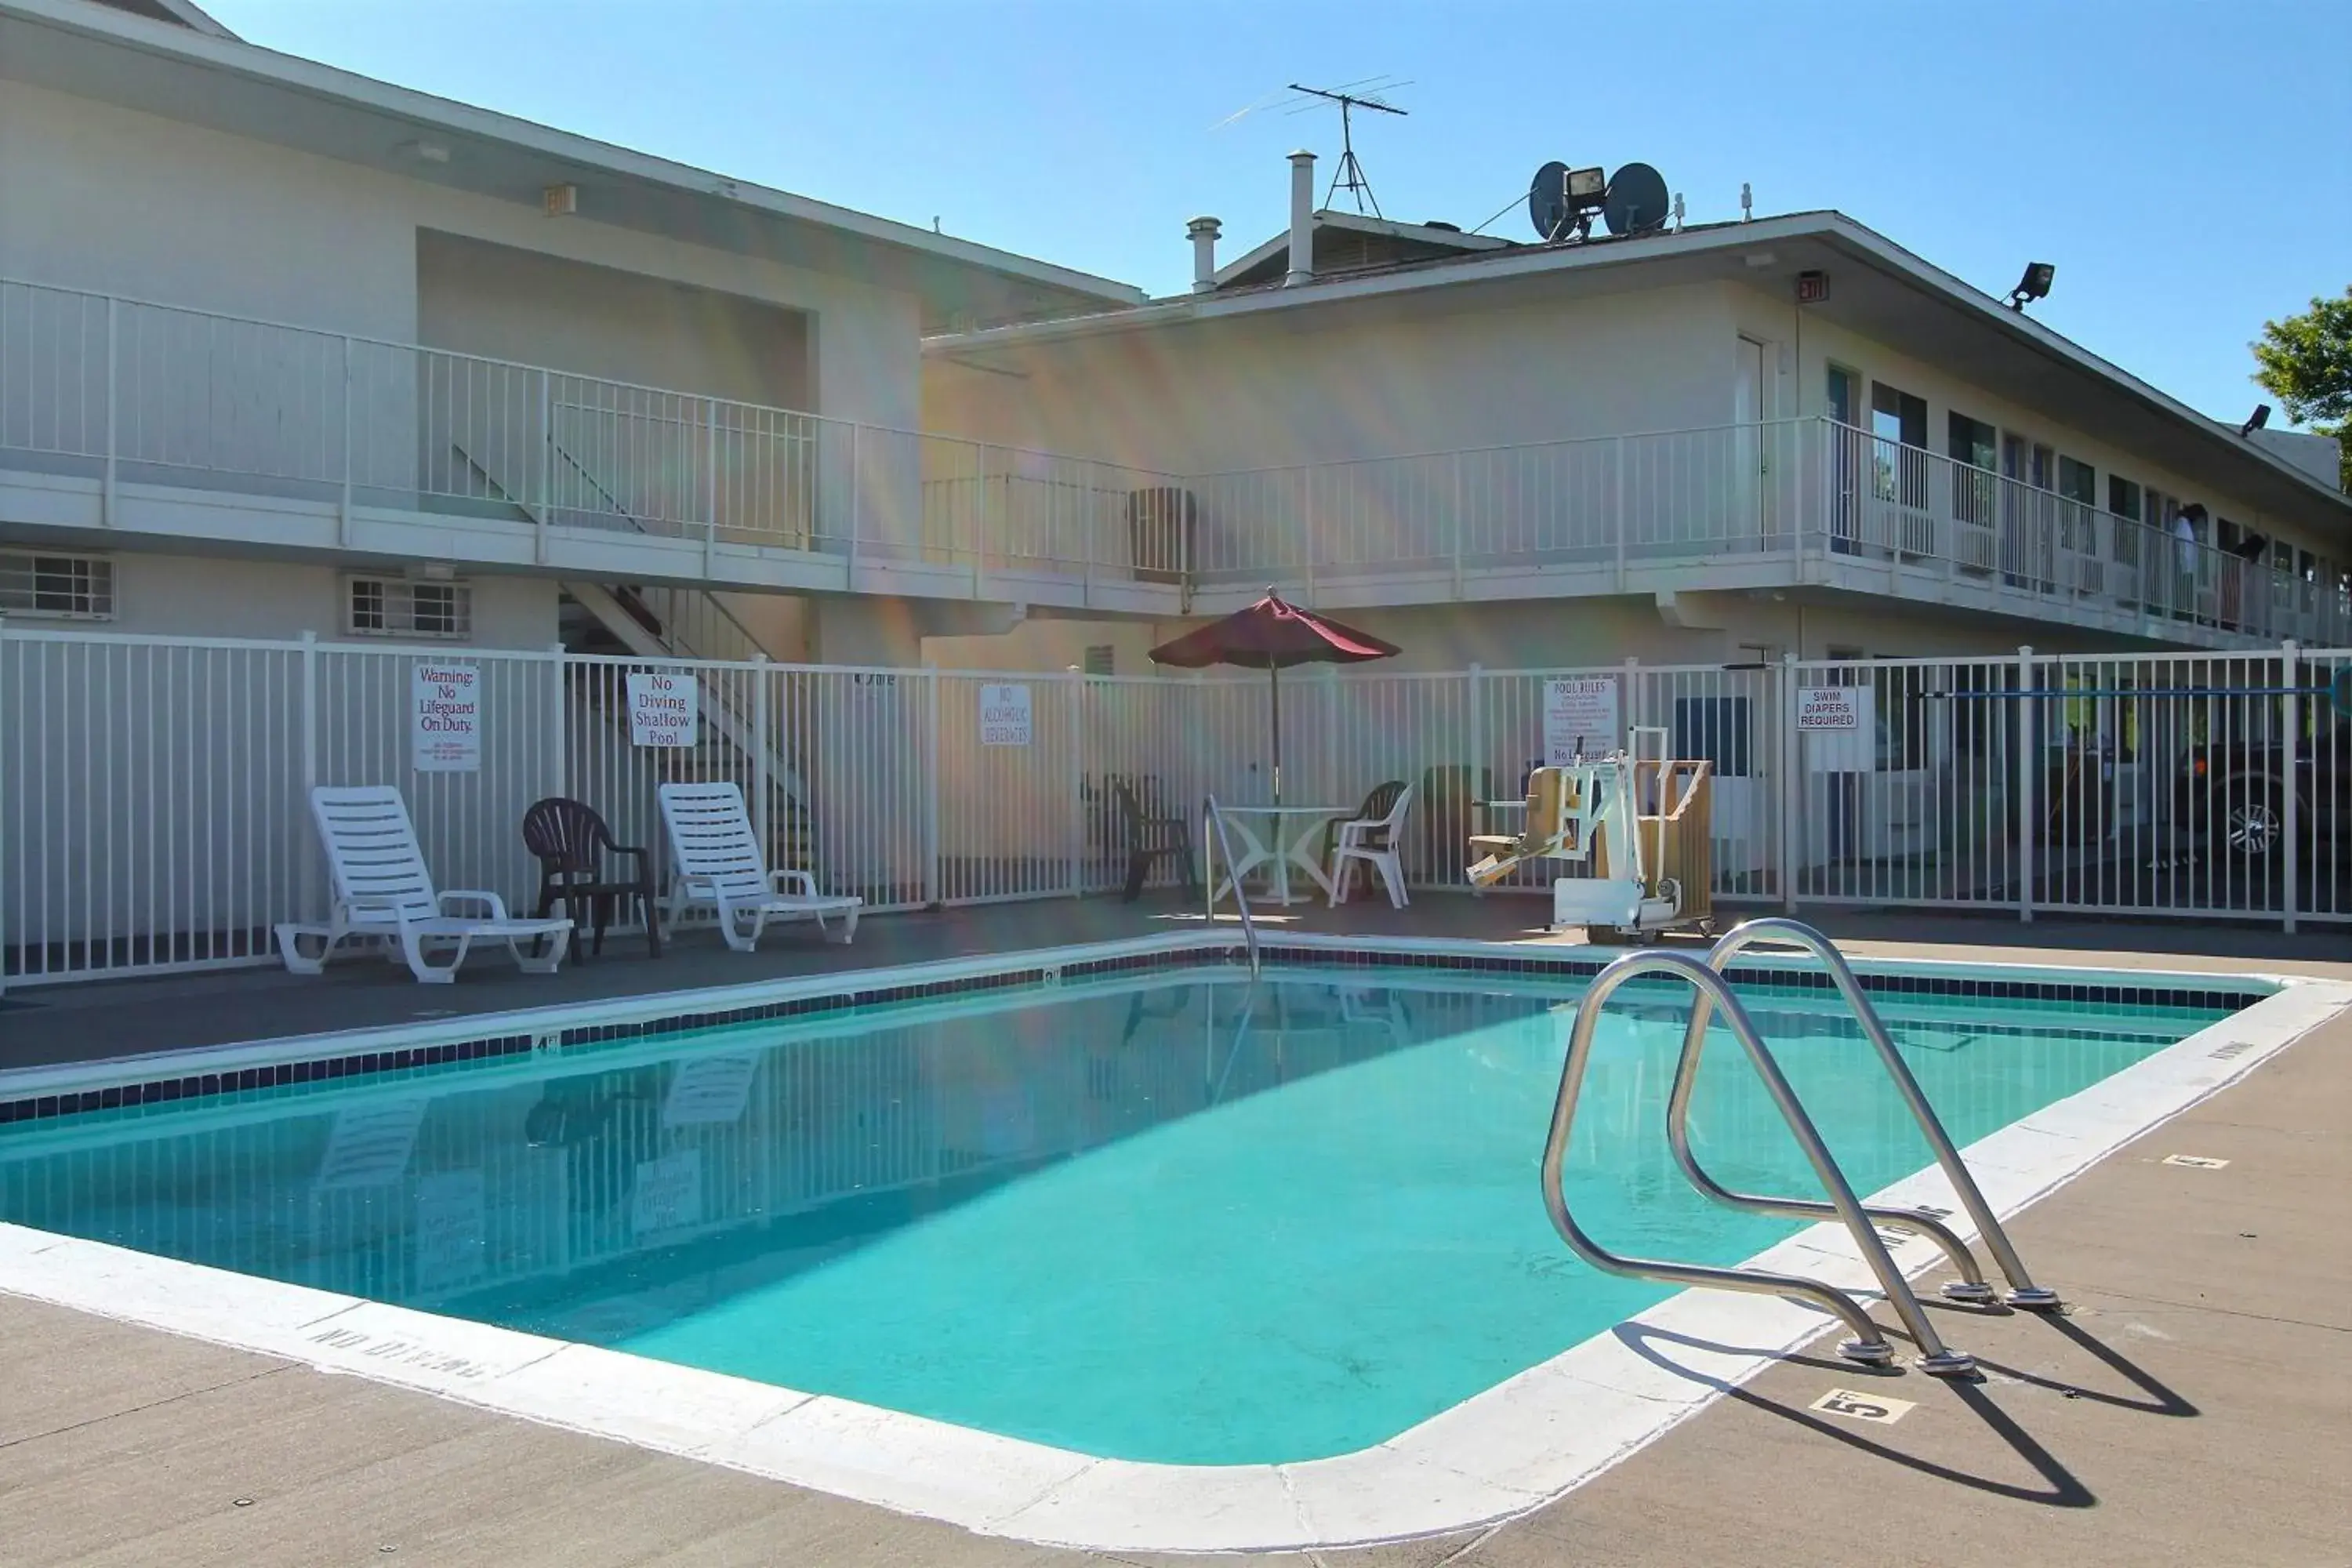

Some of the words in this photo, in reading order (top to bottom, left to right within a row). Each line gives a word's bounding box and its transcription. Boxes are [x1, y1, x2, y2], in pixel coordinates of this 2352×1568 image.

[420, 667, 474, 687] Warning:
[652, 676, 672, 690] No
[438, 685, 456, 699] No
[1555, 683, 1577, 694] POOL
[1579, 681, 1606, 693] RULES
[639, 694, 686, 713] Diving
[1813, 691, 1841, 702] SWIM
[419, 699, 474, 717] Lifeguard
[1806, 703, 1849, 713] DIAPERS
[421, 717, 440, 731] On
[636, 711, 691, 728] Shallow
[1801, 714, 1854, 725] REQUIRED
[649, 730, 678, 746] Pool
[1555, 749, 1567, 760] No
[1821, 1399, 1889, 1417] 5
